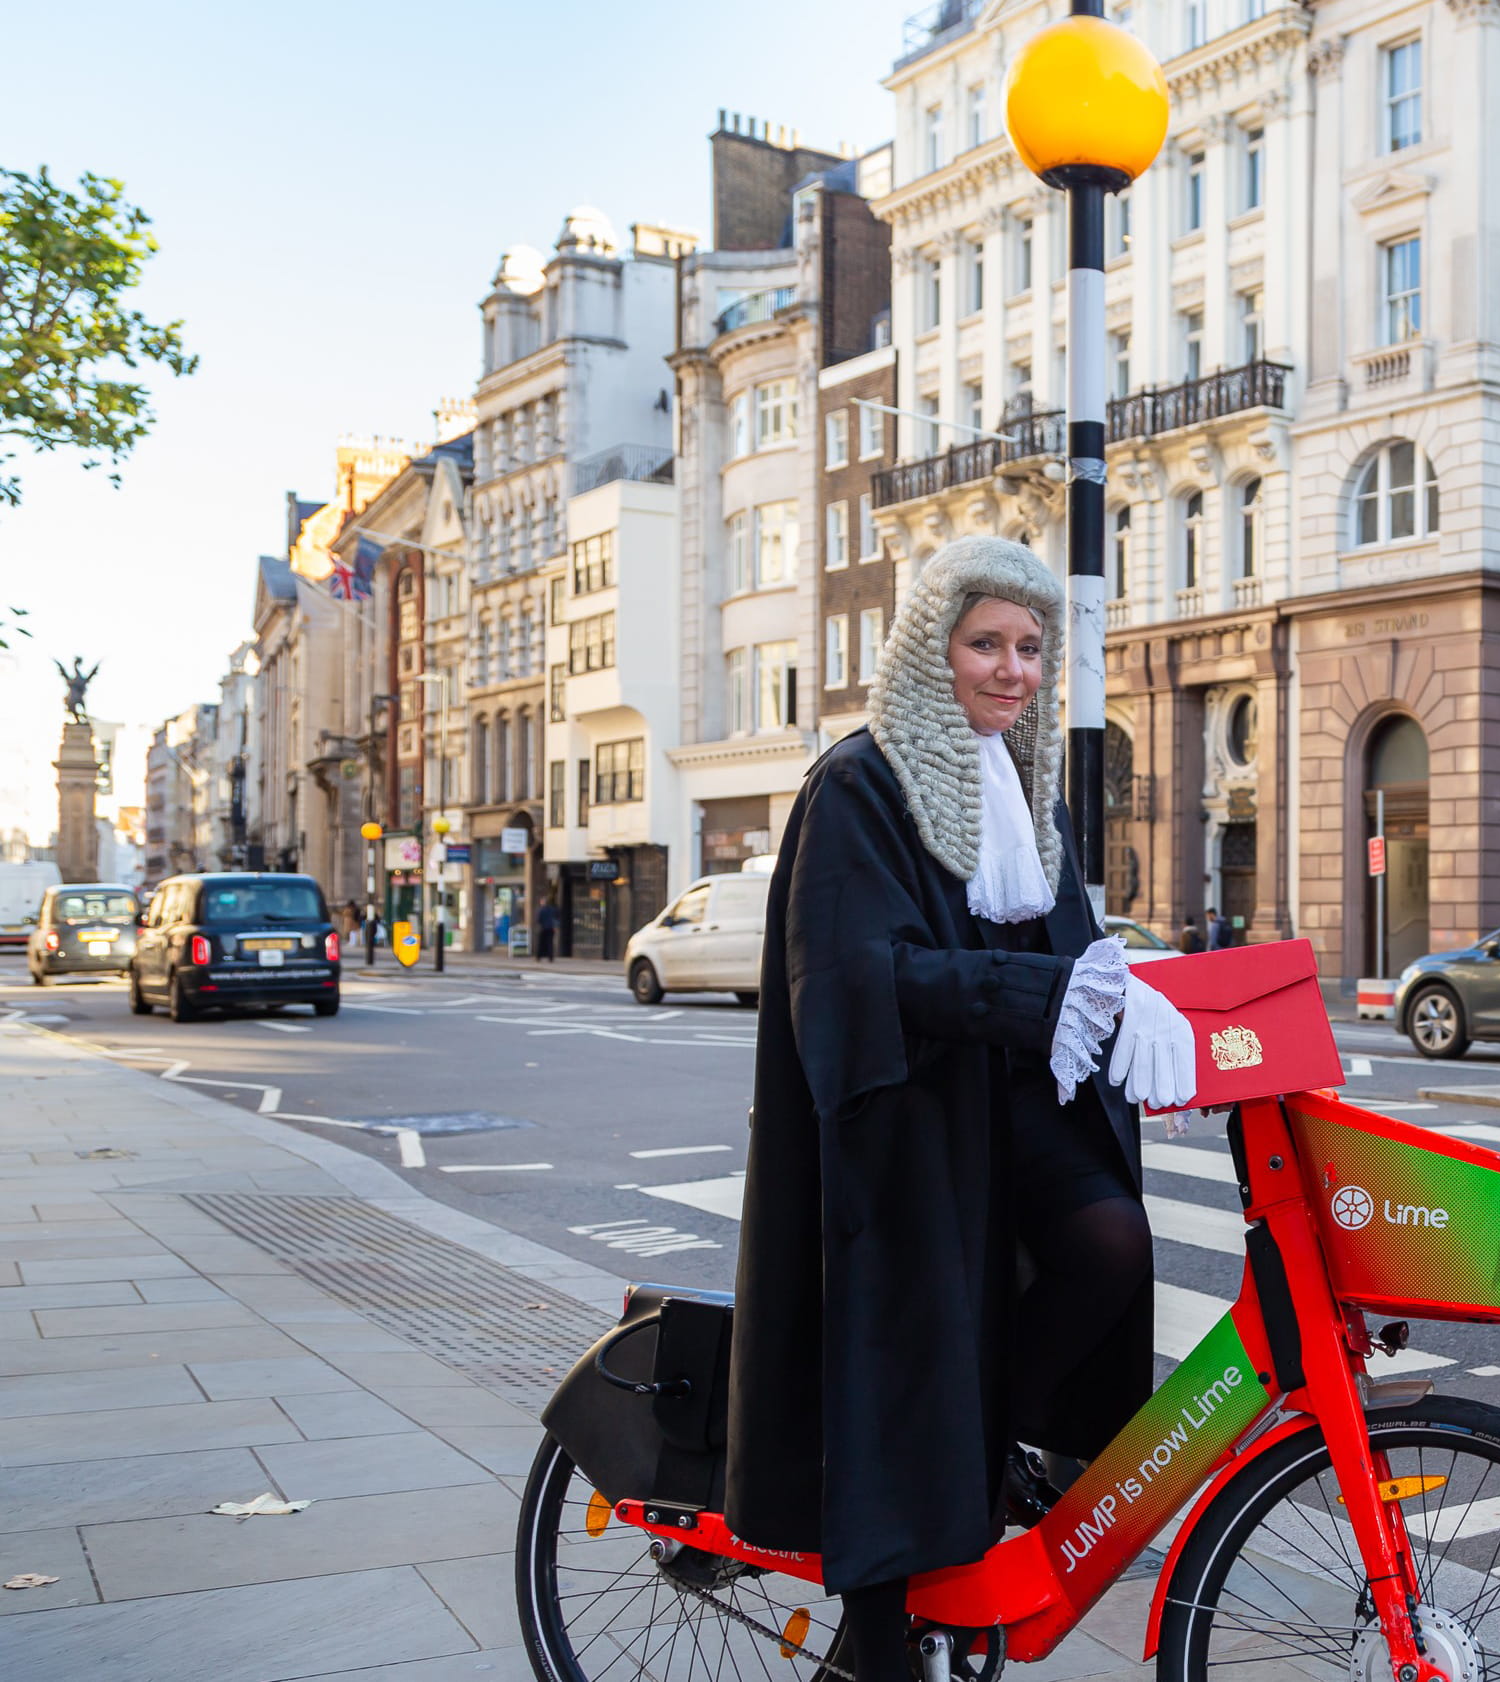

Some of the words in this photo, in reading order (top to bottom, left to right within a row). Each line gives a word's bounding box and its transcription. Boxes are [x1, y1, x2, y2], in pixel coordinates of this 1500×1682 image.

[1383, 1199, 1449, 1229] Lime
[566, 1218, 724, 1258] LOOK
[1060, 1494, 1117, 1574] JUMP
[1115, 1477, 1143, 1504] is
[1138, 1422, 1190, 1483] now
[1181, 1366, 1243, 1430] Lime
